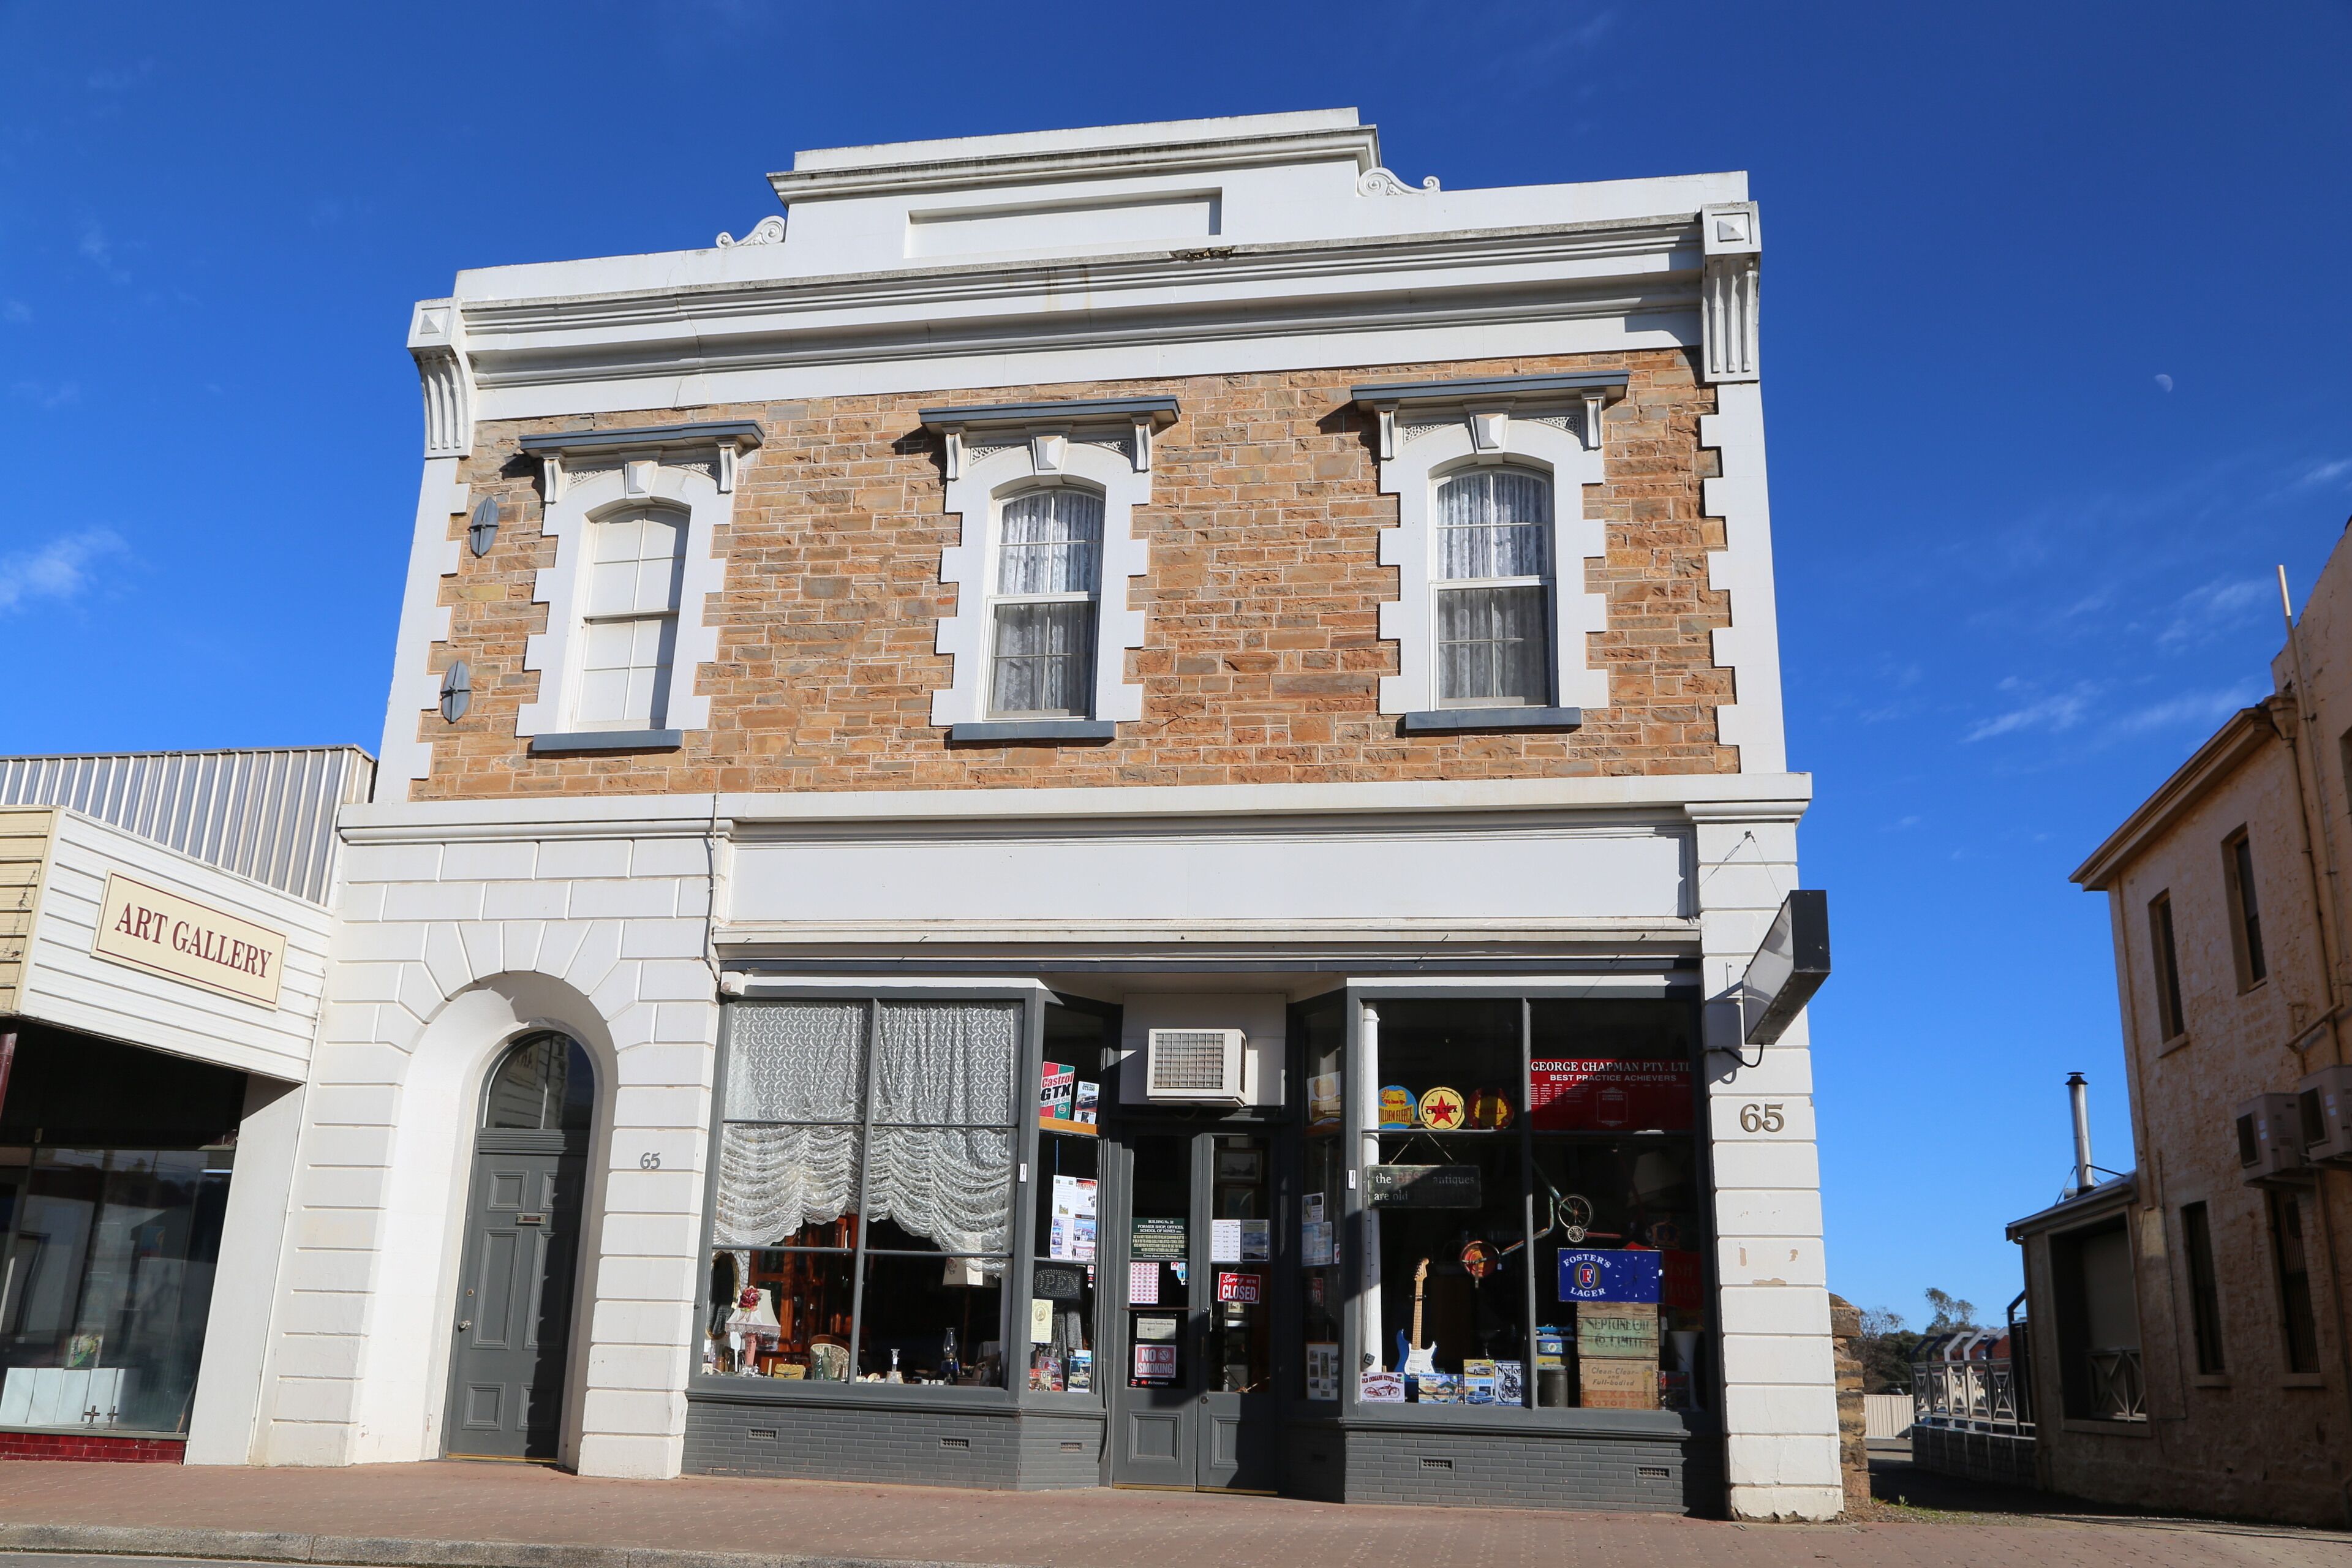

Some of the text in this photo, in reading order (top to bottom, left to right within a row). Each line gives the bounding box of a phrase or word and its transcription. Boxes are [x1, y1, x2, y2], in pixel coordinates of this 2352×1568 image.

[115, 903, 272, 978] ART GALLERY
[1531, 1061, 1578, 1072] GEORGE
[1581, 1061, 1639, 1072] CHAPMAN
[1643, 1062, 1668, 1072] PTY.
[1042, 1072, 1074, 1088] Castrol
[1041, 1084, 1071, 1101] GTX
[1396, 1106, 1412, 1123] FLEECE
[1425, 1106, 1458, 1115] CALTEX
[1740, 1102, 1784, 1133] 65
[640, 1152, 660, 1169] 65
[1376, 1173, 1392, 1184] the
[1433, 1174, 1474, 1187] antiques
[1374, 1191, 1389, 1200] are
[1392, 1190, 1408, 1200] old
[1563, 1254, 1611, 1268] FOSTER'S
[1223, 1274, 1244, 1285] Sorry
[1222, 1284, 1256, 1300] CLOSED
[1570, 1287, 1607, 1297] LAGER
[1141, 1349, 1156, 1362] NO
[1137, 1363, 1172, 1374] SMOKING
[1495, 1363, 1522, 1376] Norton
